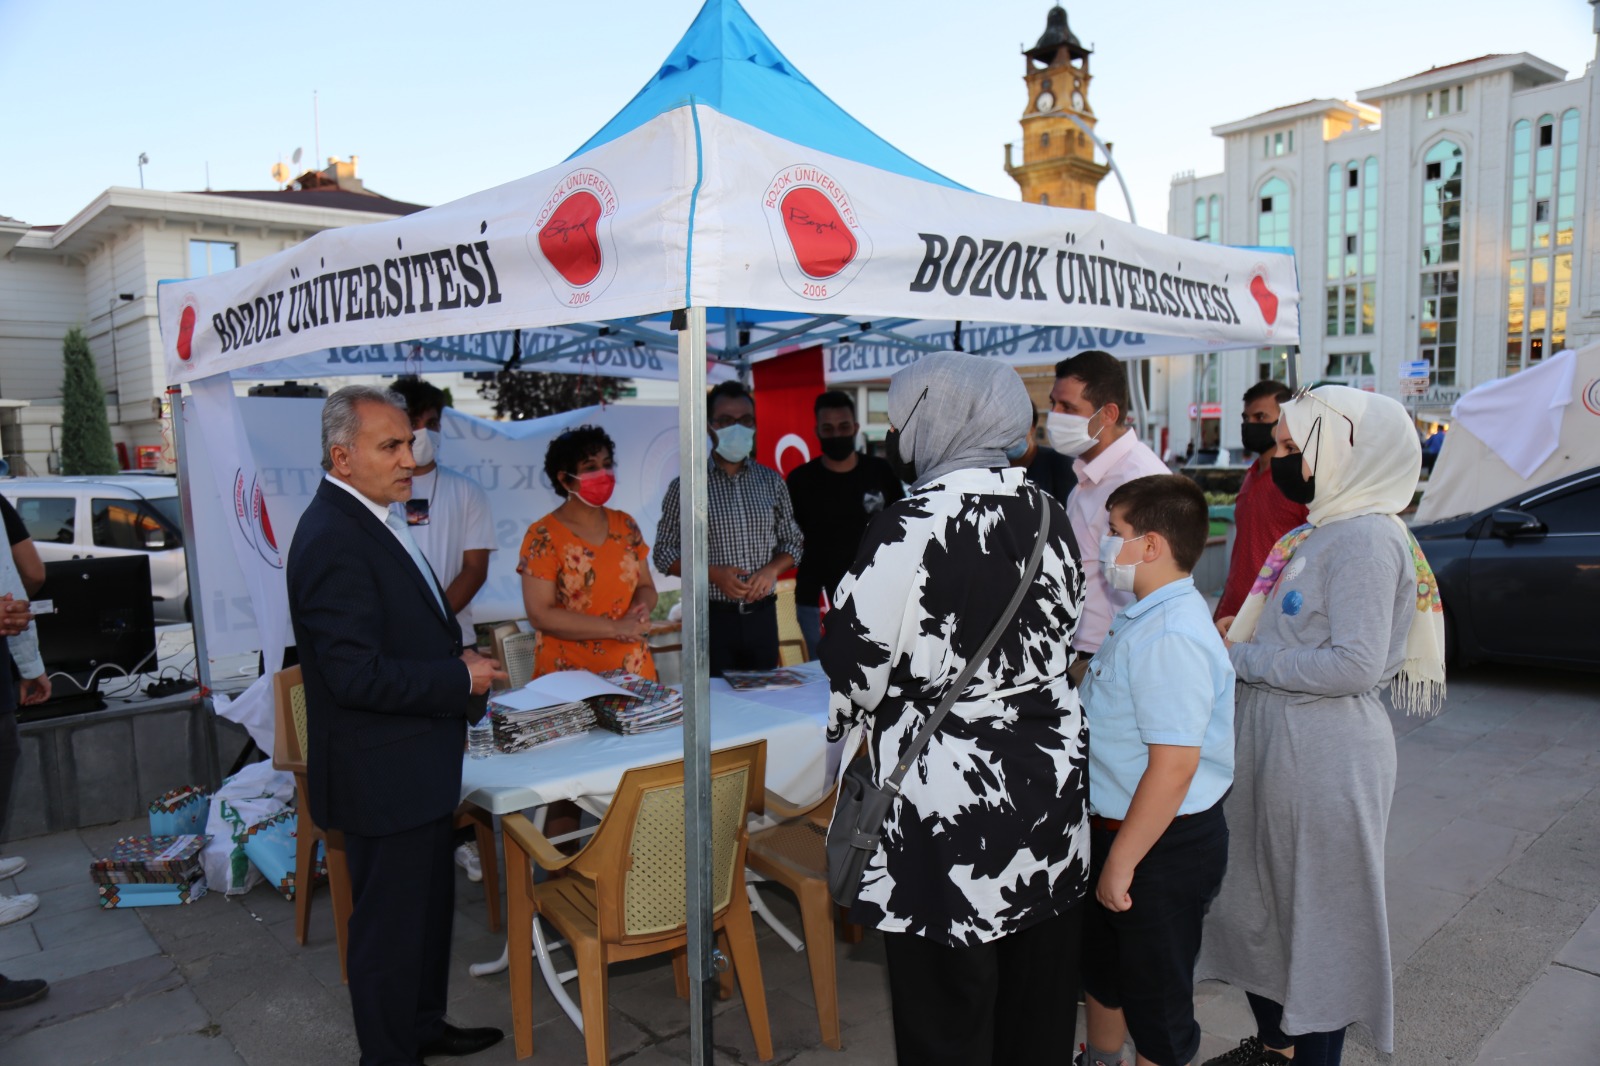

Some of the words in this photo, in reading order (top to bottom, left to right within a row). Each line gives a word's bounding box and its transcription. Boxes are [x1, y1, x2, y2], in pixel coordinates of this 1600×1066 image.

[536, 185, 565, 228] BOZOK
[566, 172, 616, 218] ÜNİVERSİTESİ
[766, 172, 792, 209] BOZOK
[795, 167, 858, 229] ÜNİVERSİTESİ
[212, 290, 284, 354] BOZOK
[288, 220, 502, 334] ÜNİVERSİTESİ
[569, 291, 590, 304] 2006
[803, 283, 827, 297] 2006
[909, 233, 1049, 301] BOZOK
[1056, 232, 1241, 325] ÜNİVERSİTESİ
